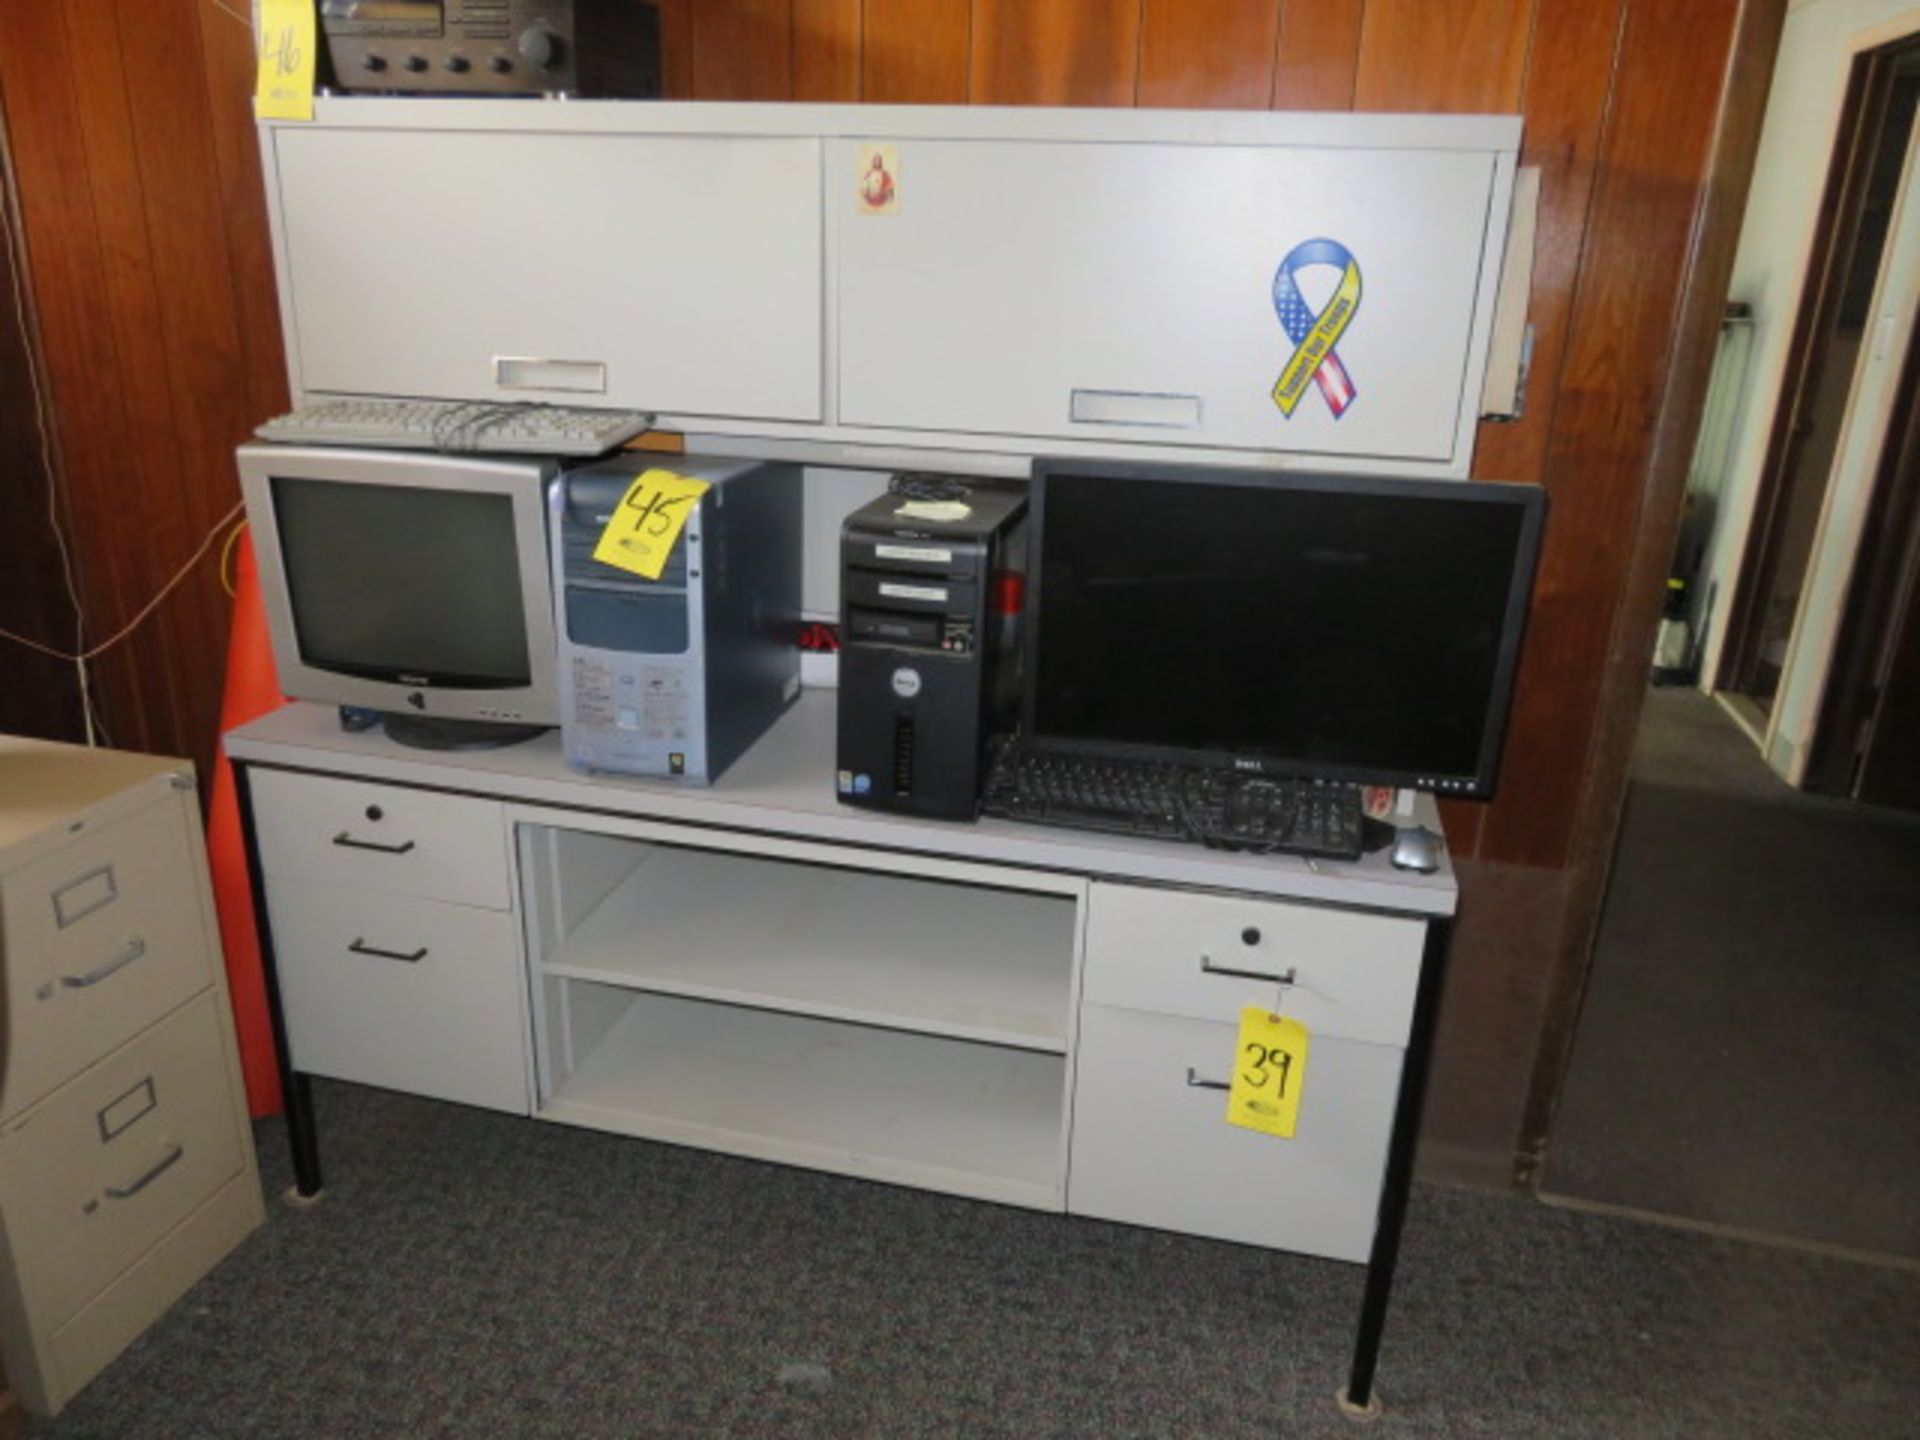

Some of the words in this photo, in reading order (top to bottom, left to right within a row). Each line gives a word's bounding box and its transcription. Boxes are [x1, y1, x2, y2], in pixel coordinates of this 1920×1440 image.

[262, 24, 301, 76] 46
[626, 485, 697, 537] 45
[1243, 1043, 1291, 1099] 39
